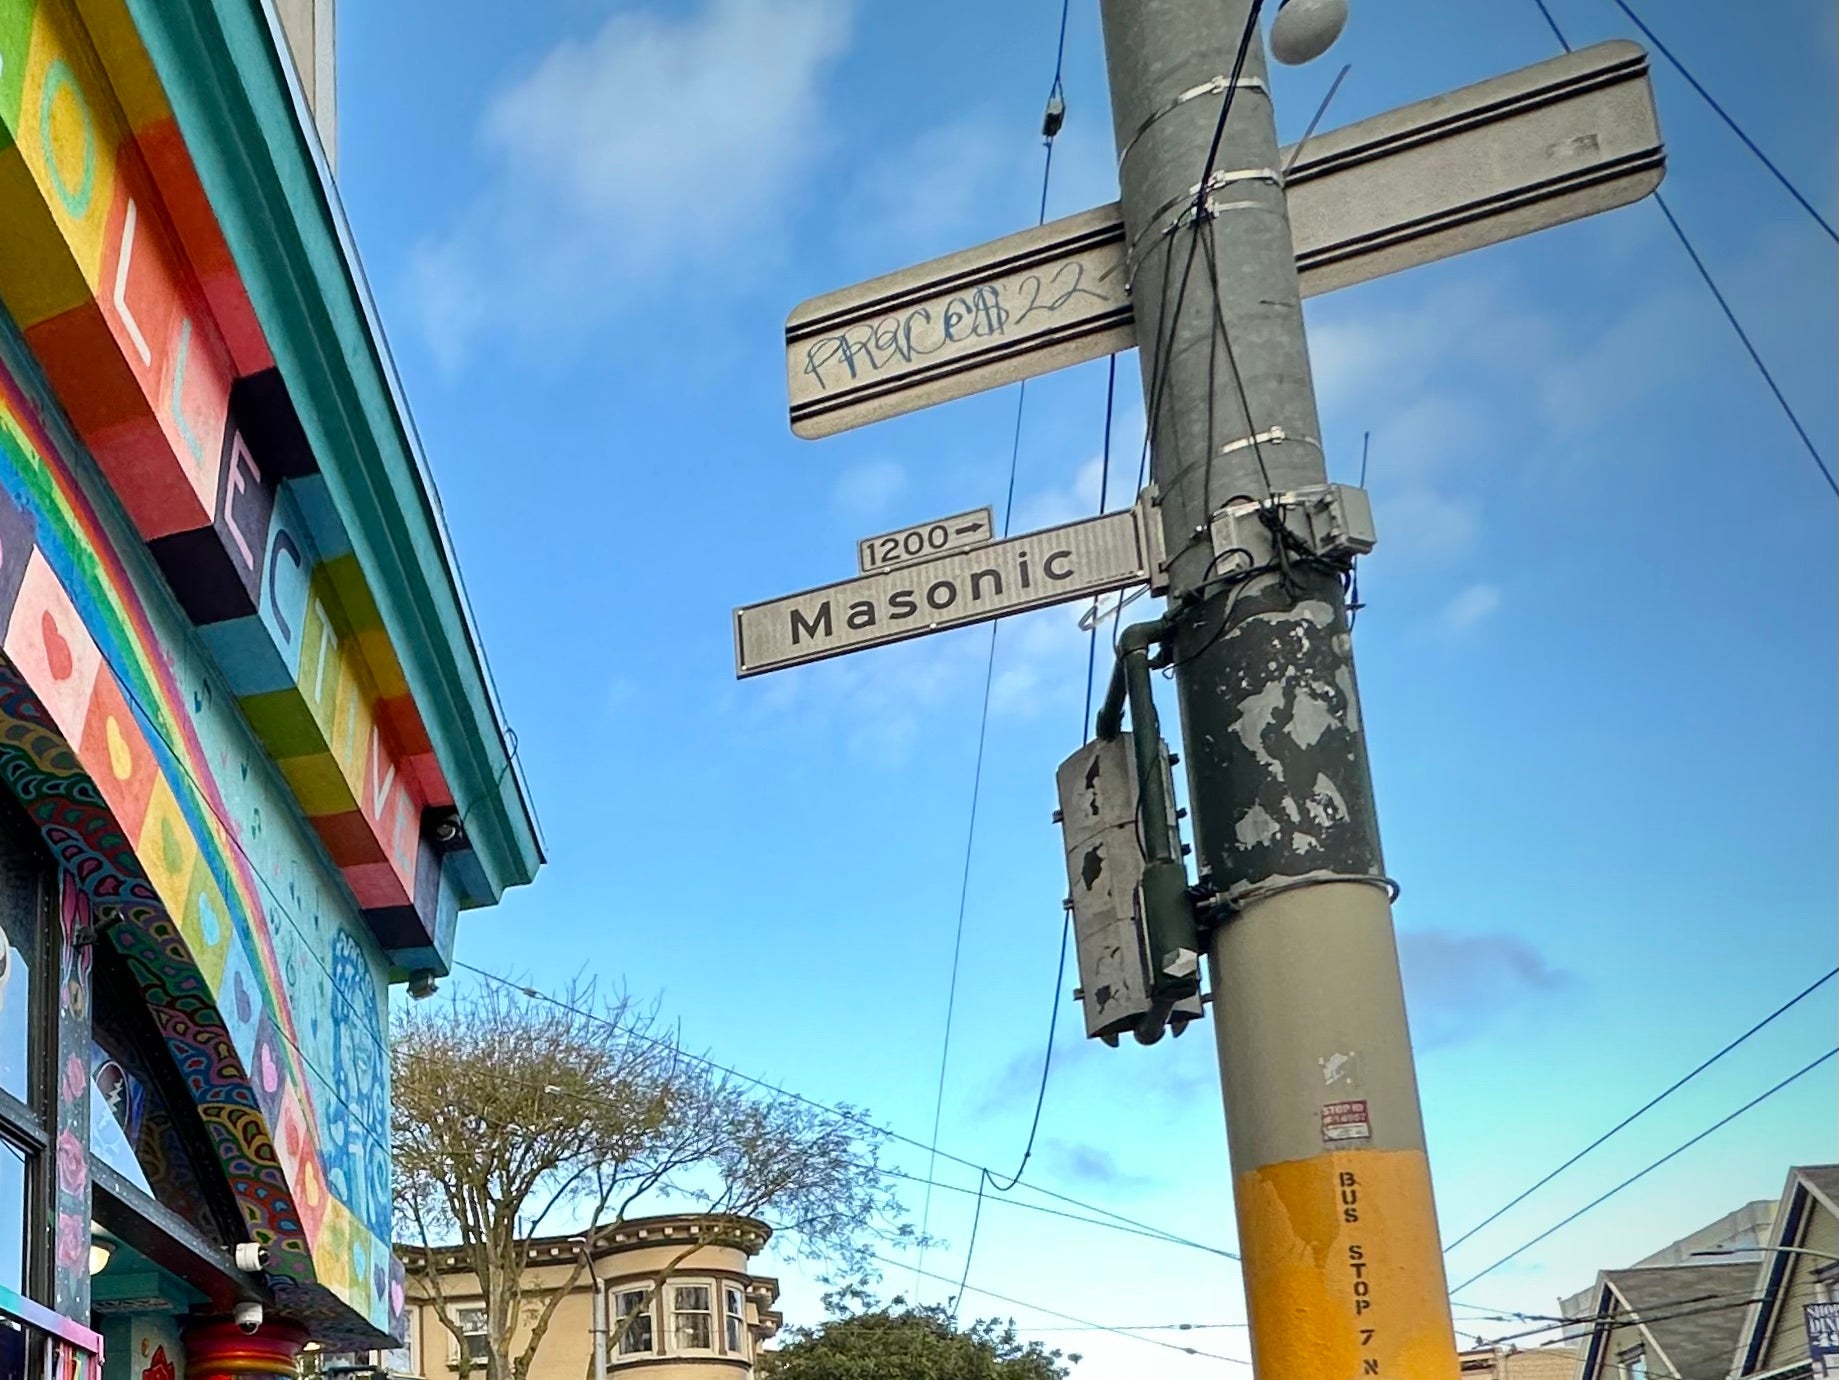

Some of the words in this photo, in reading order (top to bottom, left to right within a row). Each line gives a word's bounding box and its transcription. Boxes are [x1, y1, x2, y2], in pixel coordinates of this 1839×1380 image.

[866, 523, 950, 567] 1200
[789, 549, 1075, 645] Masonic
[1339, 1172, 1360, 1223] BUS
[1347, 1244, 1371, 1316] STOP
[1360, 1329, 1376, 1346] 7
[1363, 1359, 1378, 1375] N
